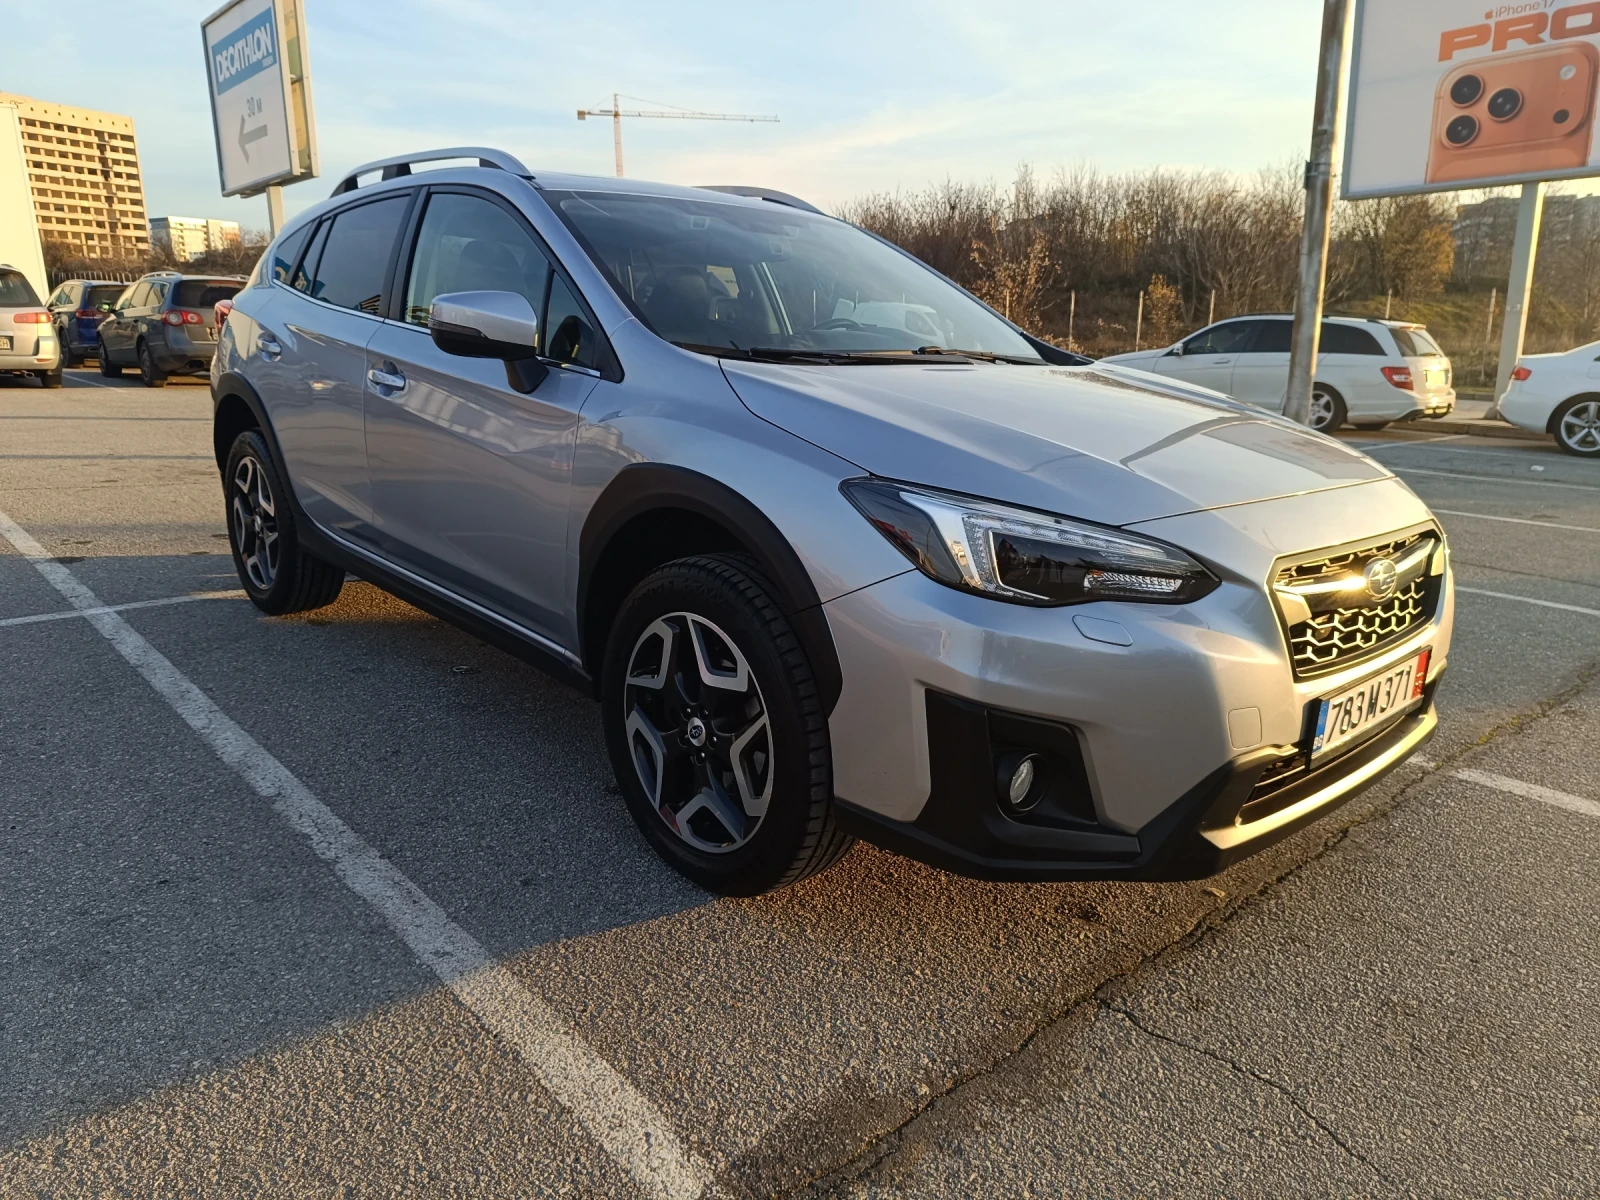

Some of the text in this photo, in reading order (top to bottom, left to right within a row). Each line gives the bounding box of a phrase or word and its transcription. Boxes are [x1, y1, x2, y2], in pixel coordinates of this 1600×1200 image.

[1495, 1, 1541, 18] iPhone
[1438, 1, 1600, 62] PRO
[215, 23, 273, 83] DECATHLON
[246, 96, 256, 118] 30
